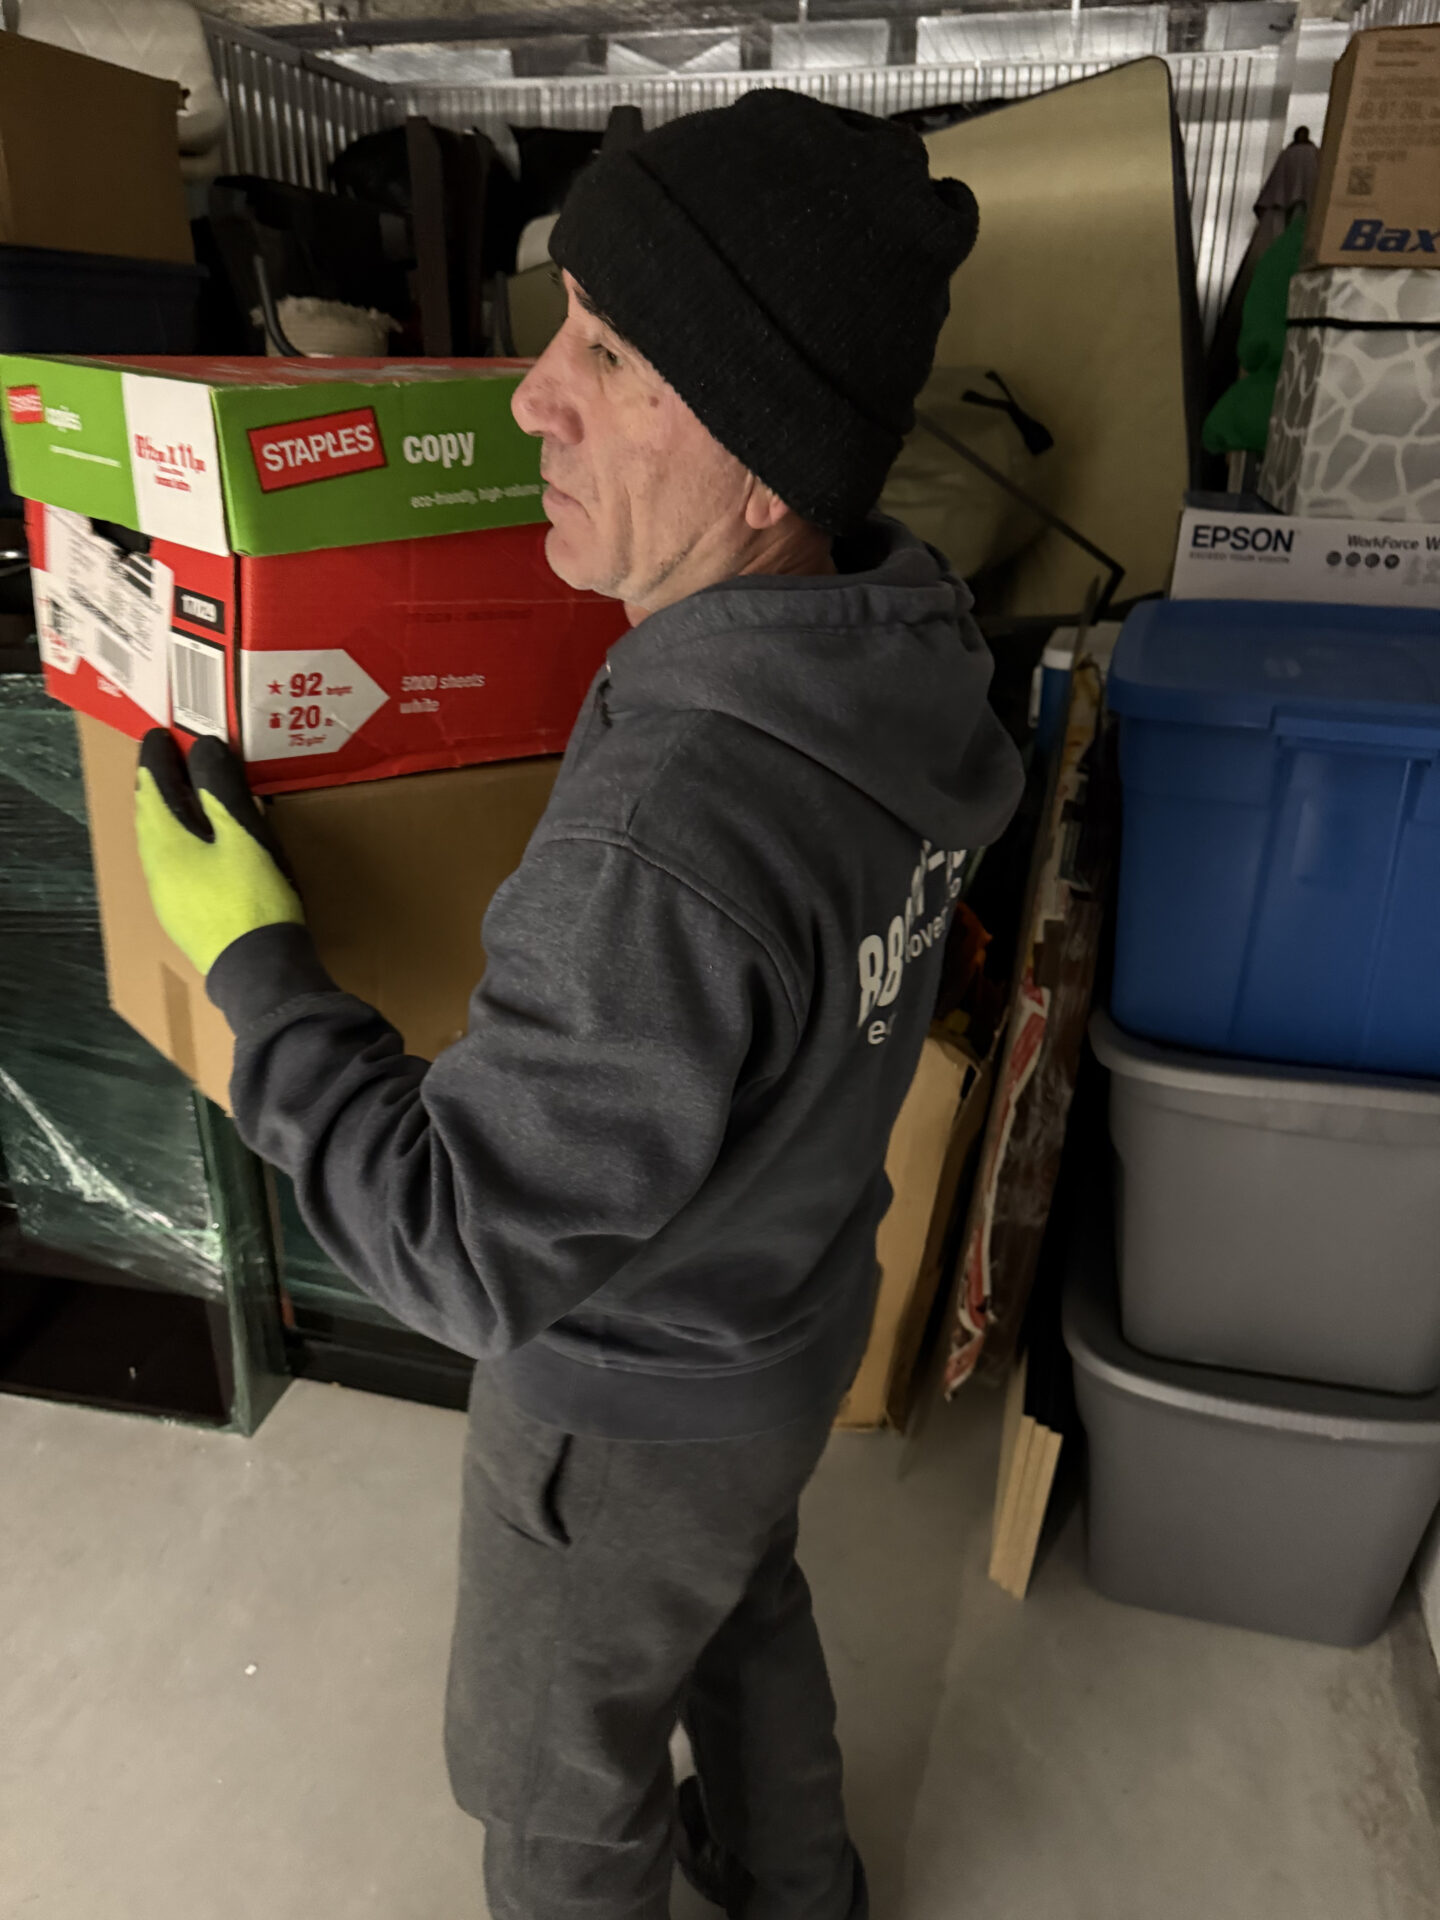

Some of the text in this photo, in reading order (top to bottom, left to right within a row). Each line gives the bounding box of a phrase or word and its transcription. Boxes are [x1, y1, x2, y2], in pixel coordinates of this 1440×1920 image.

[1340, 219, 1440, 253] Bax
[262, 424, 475, 472] STAPLES copy
[1191, 525, 1294, 552] EPSON
[1347, 534, 1419, 549] WorkForce
[289, 672, 323, 697] 92
[402, 674, 486, 692] 5000 sheets
[288, 705, 321, 731] 20
[400, 698, 440, 714] white
[288, 733, 305, 747] 75
